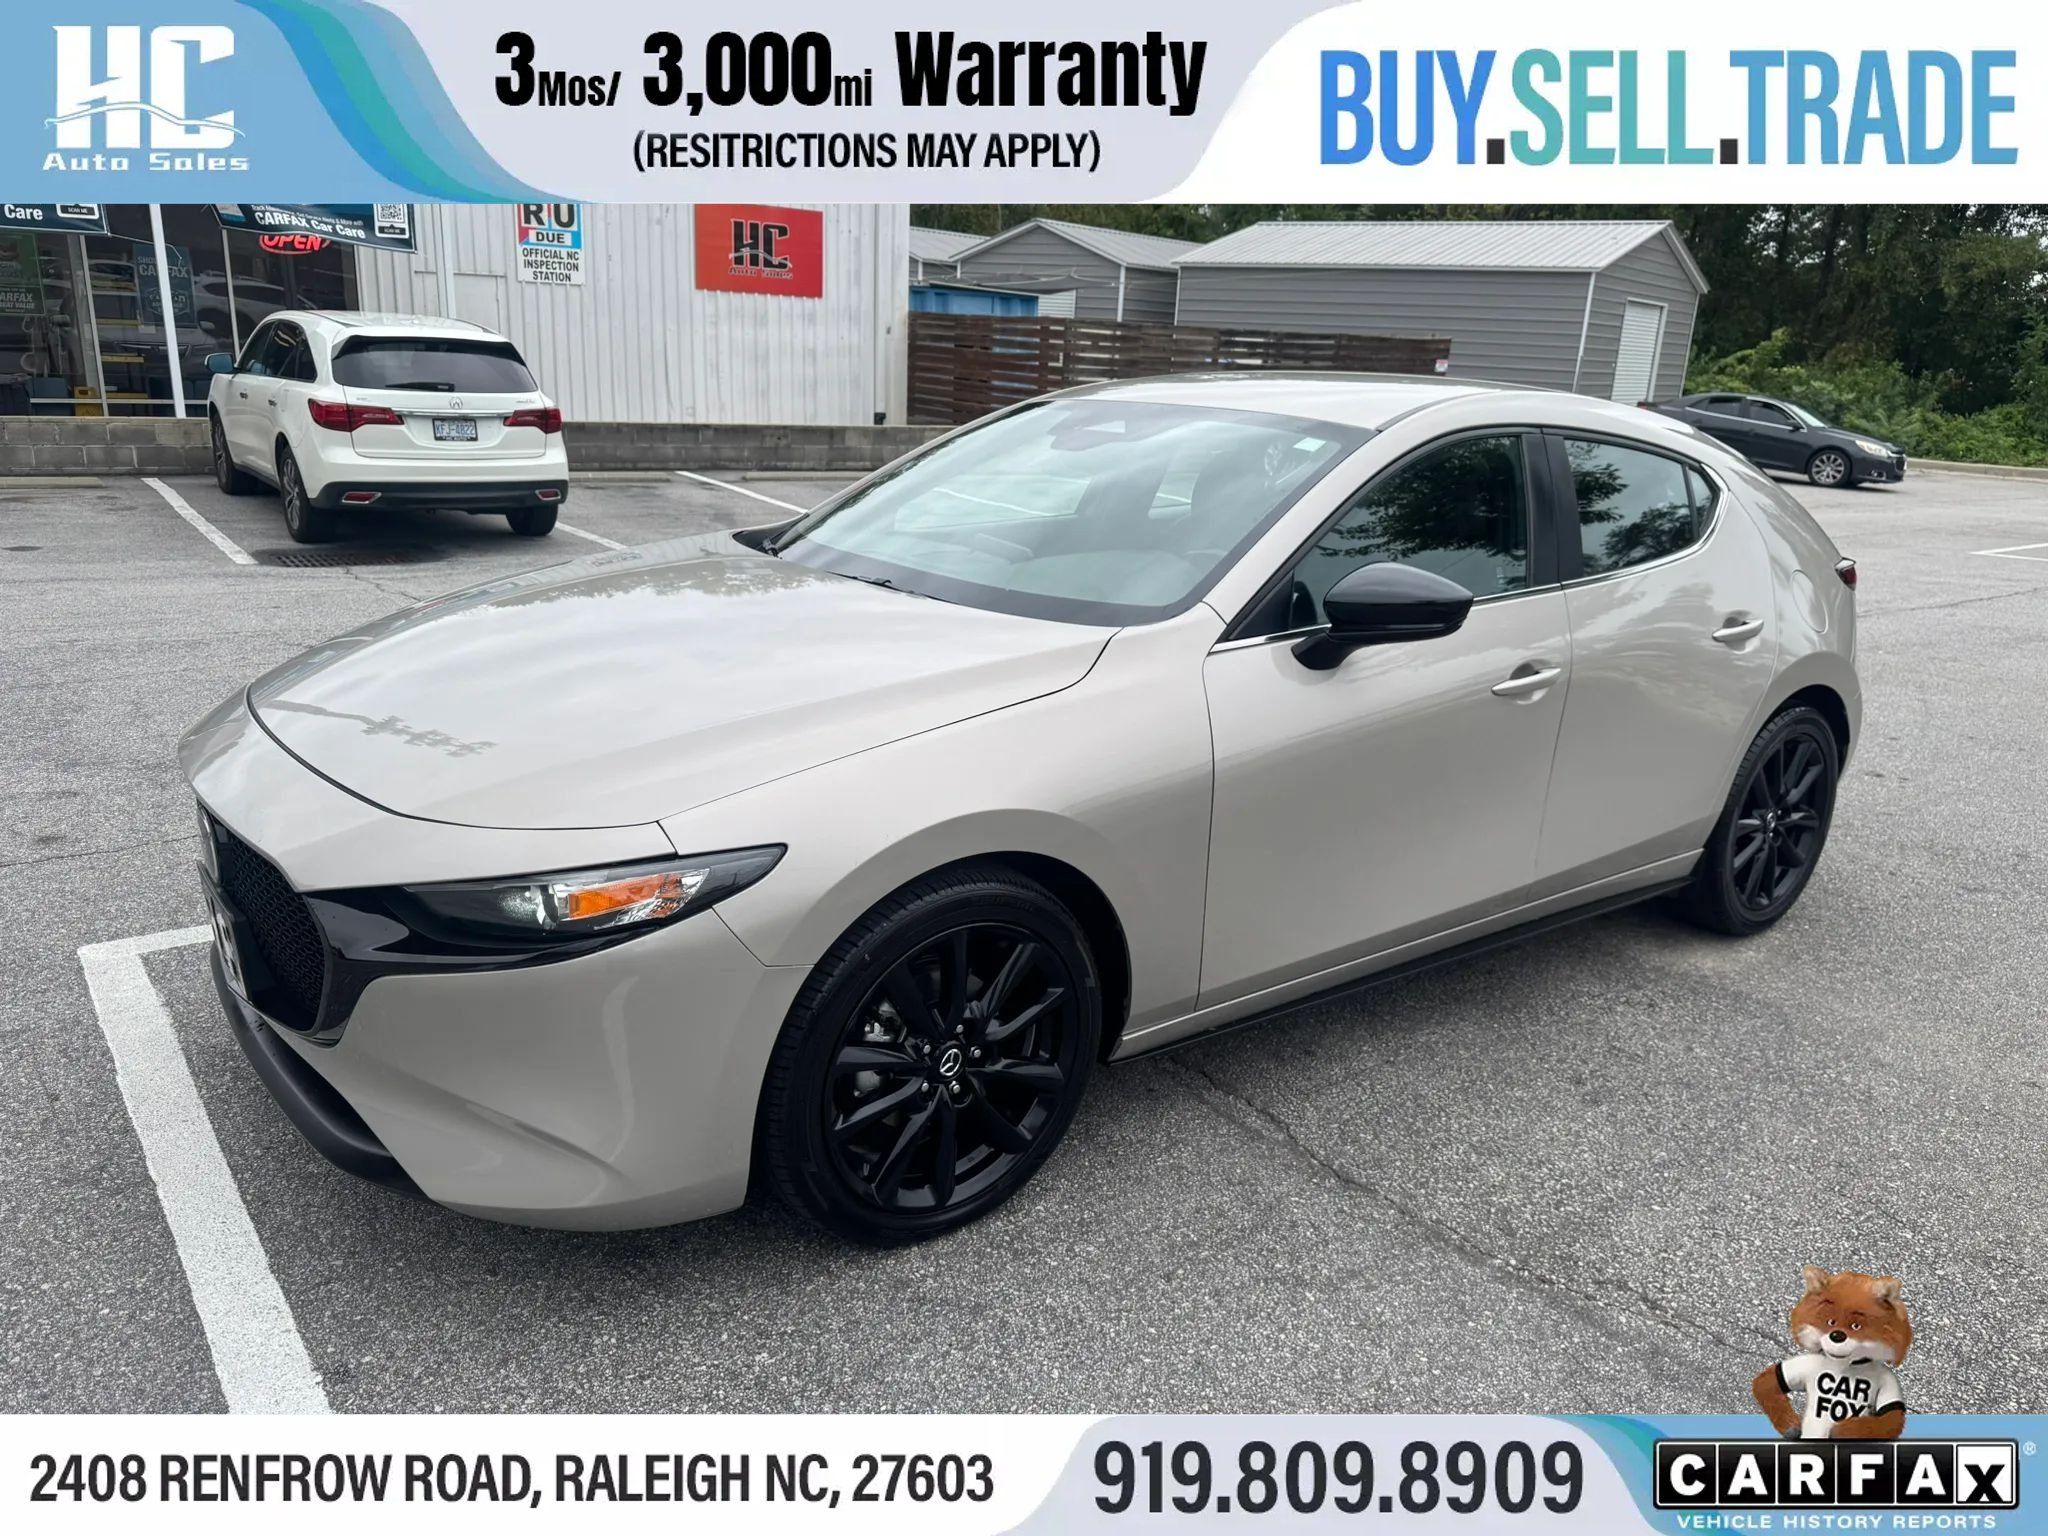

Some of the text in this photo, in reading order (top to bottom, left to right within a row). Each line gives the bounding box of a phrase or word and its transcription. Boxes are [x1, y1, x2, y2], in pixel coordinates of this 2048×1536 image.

[4, 204, 43, 220] Care
[254, 211, 310, 229] CARFAX
[310, 220, 333, 233] Car
[335, 224, 367, 240] Care
[263, 234, 323, 251] OPEN
[535, 231, 566, 244] DUE
[731, 219, 790, 271] HC
[522, 248, 580, 261] OFFICIAL NC
[523, 258, 580, 273] INSPECTION
[532, 270, 572, 283] STATION
